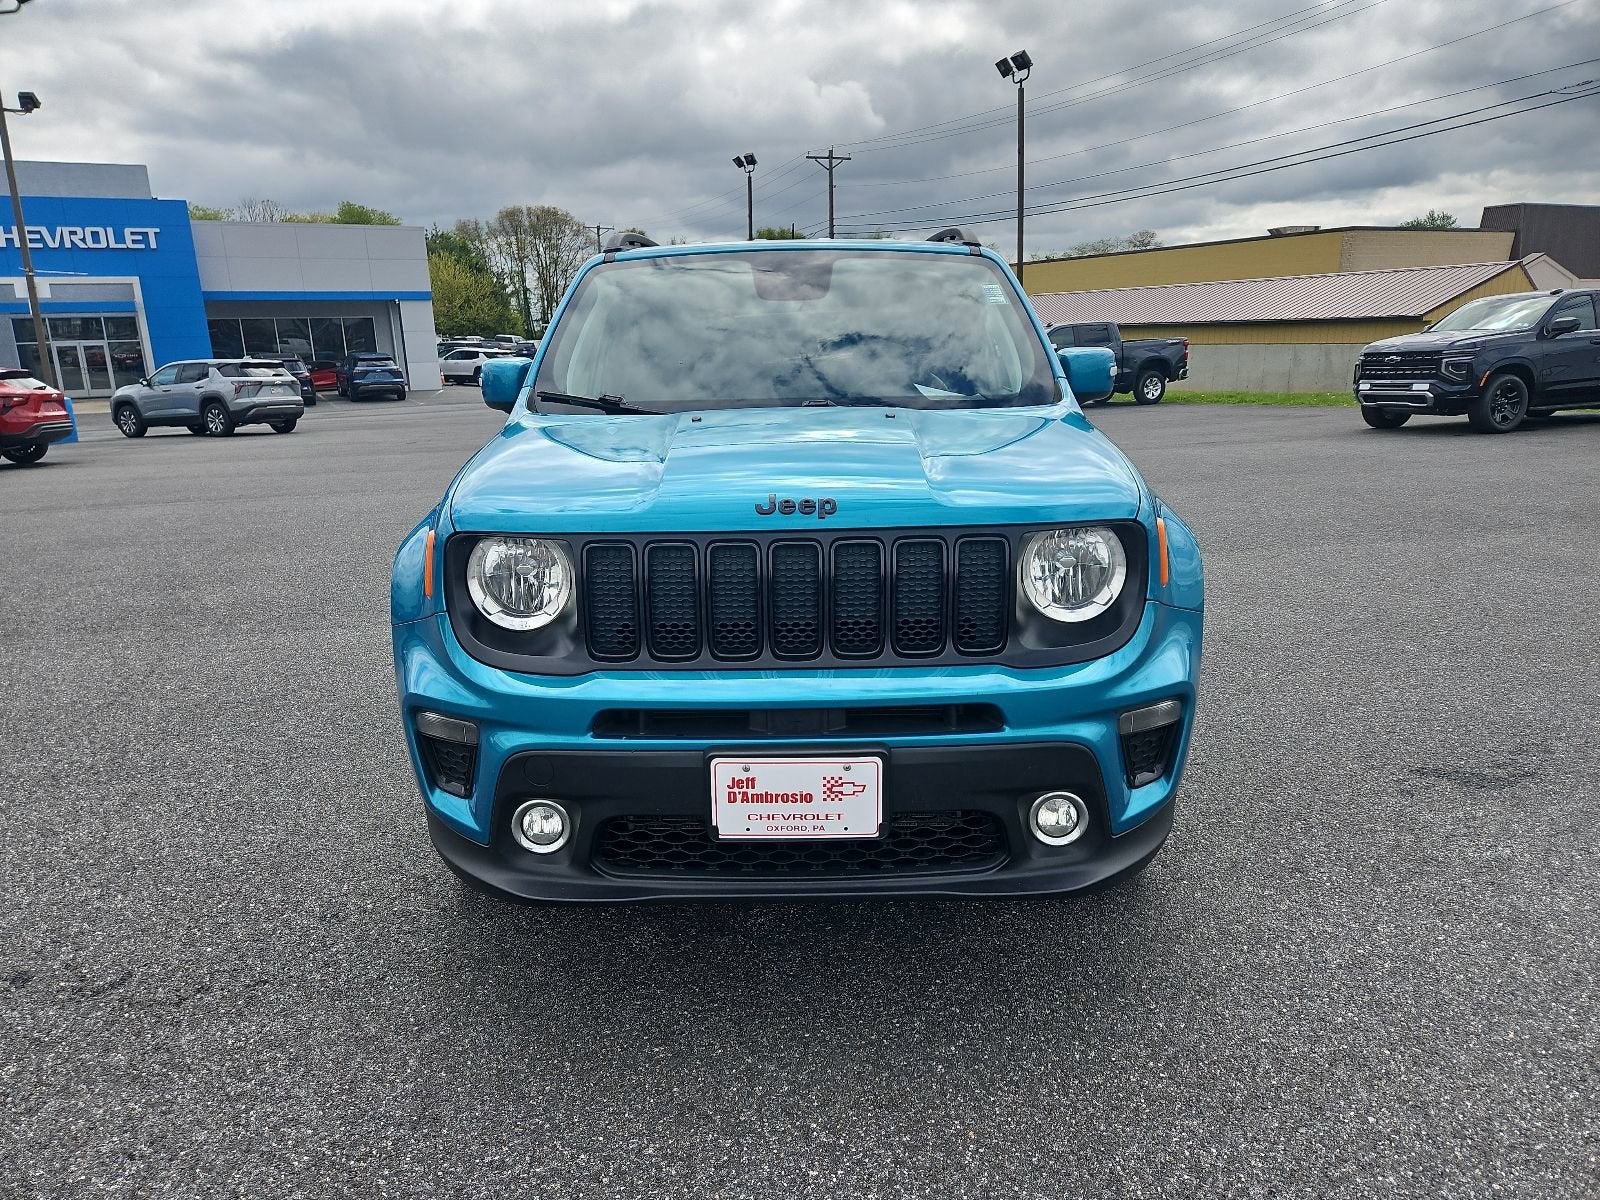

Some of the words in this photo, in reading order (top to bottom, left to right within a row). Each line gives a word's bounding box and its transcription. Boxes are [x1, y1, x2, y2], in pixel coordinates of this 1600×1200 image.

[0, 225, 160, 249] HEVROLET
[755, 494, 837, 519] Jeep
[727, 777, 756, 789] Jeff
[727, 791, 813, 803] D'Ambrosio
[747, 813, 843, 821] CHEVROLET
